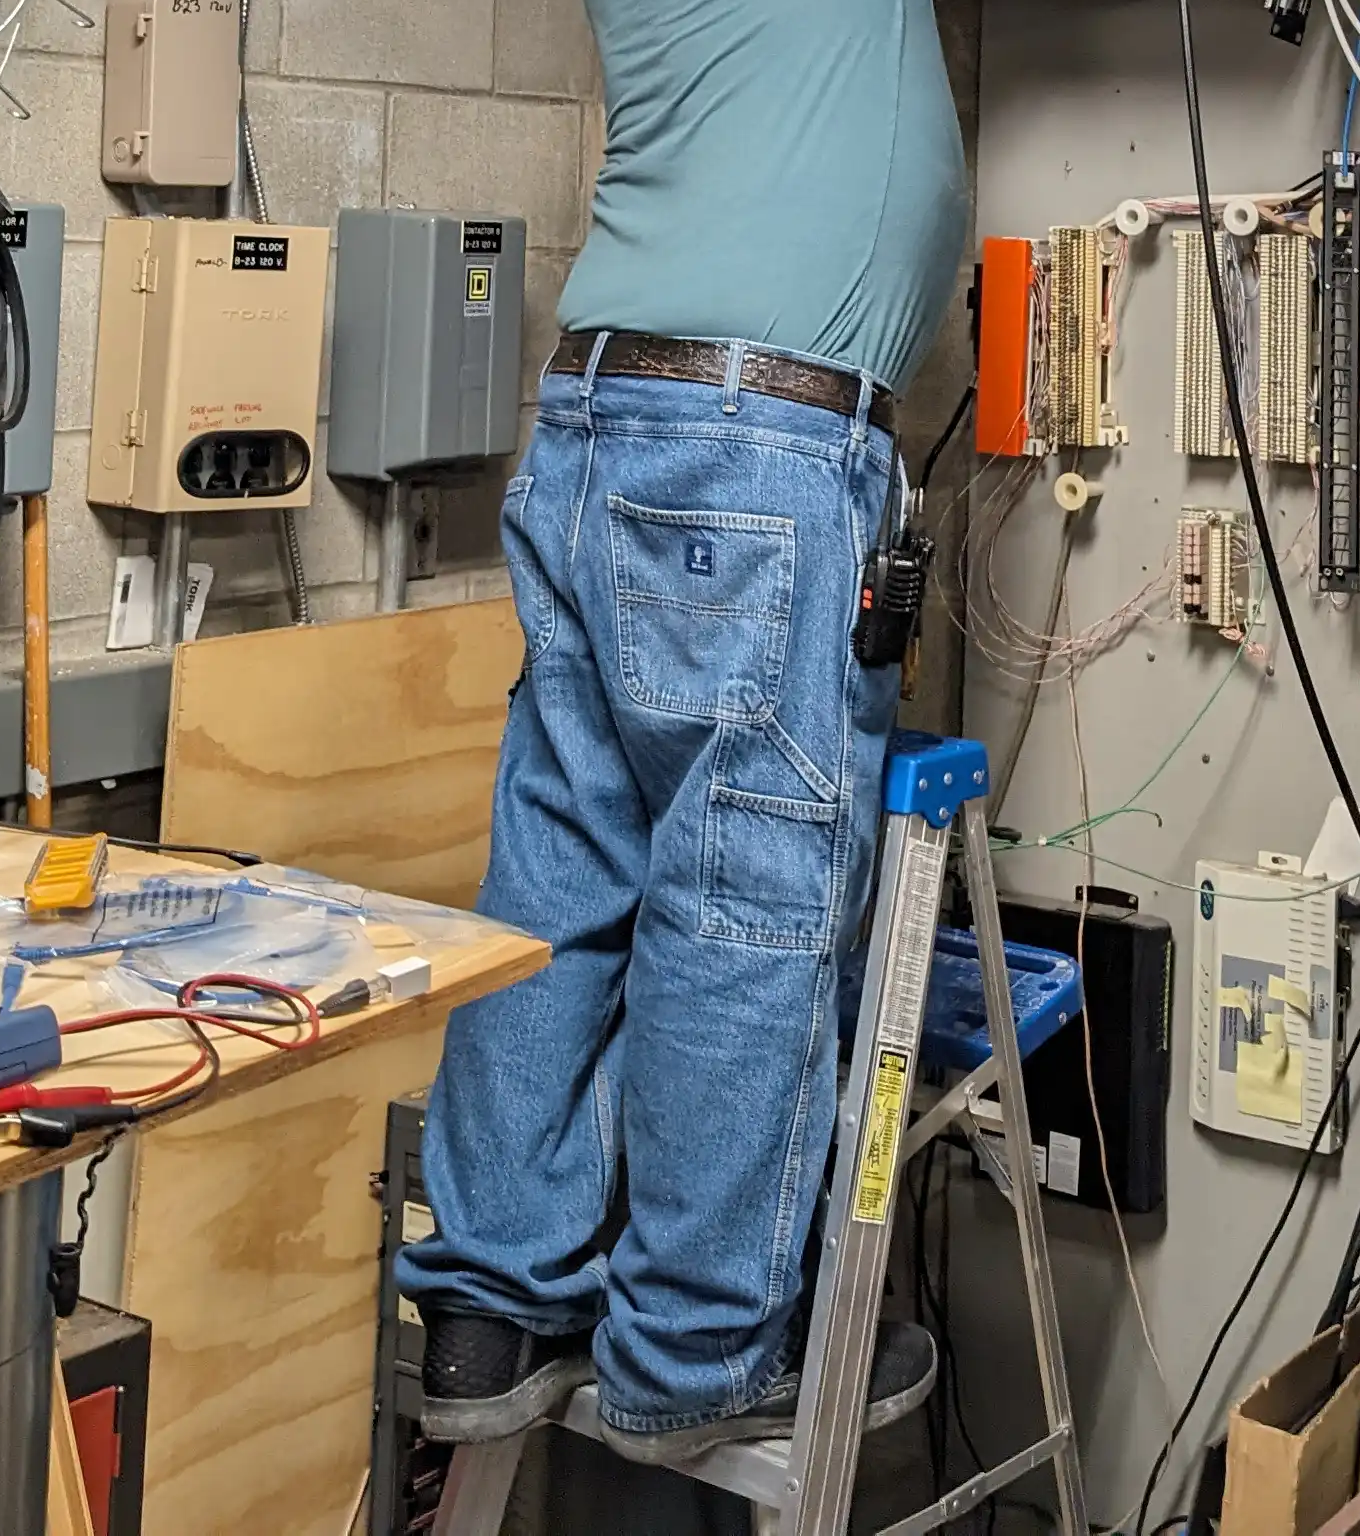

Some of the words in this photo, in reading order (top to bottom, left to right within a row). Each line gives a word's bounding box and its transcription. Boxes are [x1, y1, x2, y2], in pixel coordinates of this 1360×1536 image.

[236, 241, 256, 251] TIME
[258, 242, 285, 252] CLOCK
[260, 257, 274, 266] 120
[185, 578, 201, 613] TORK
